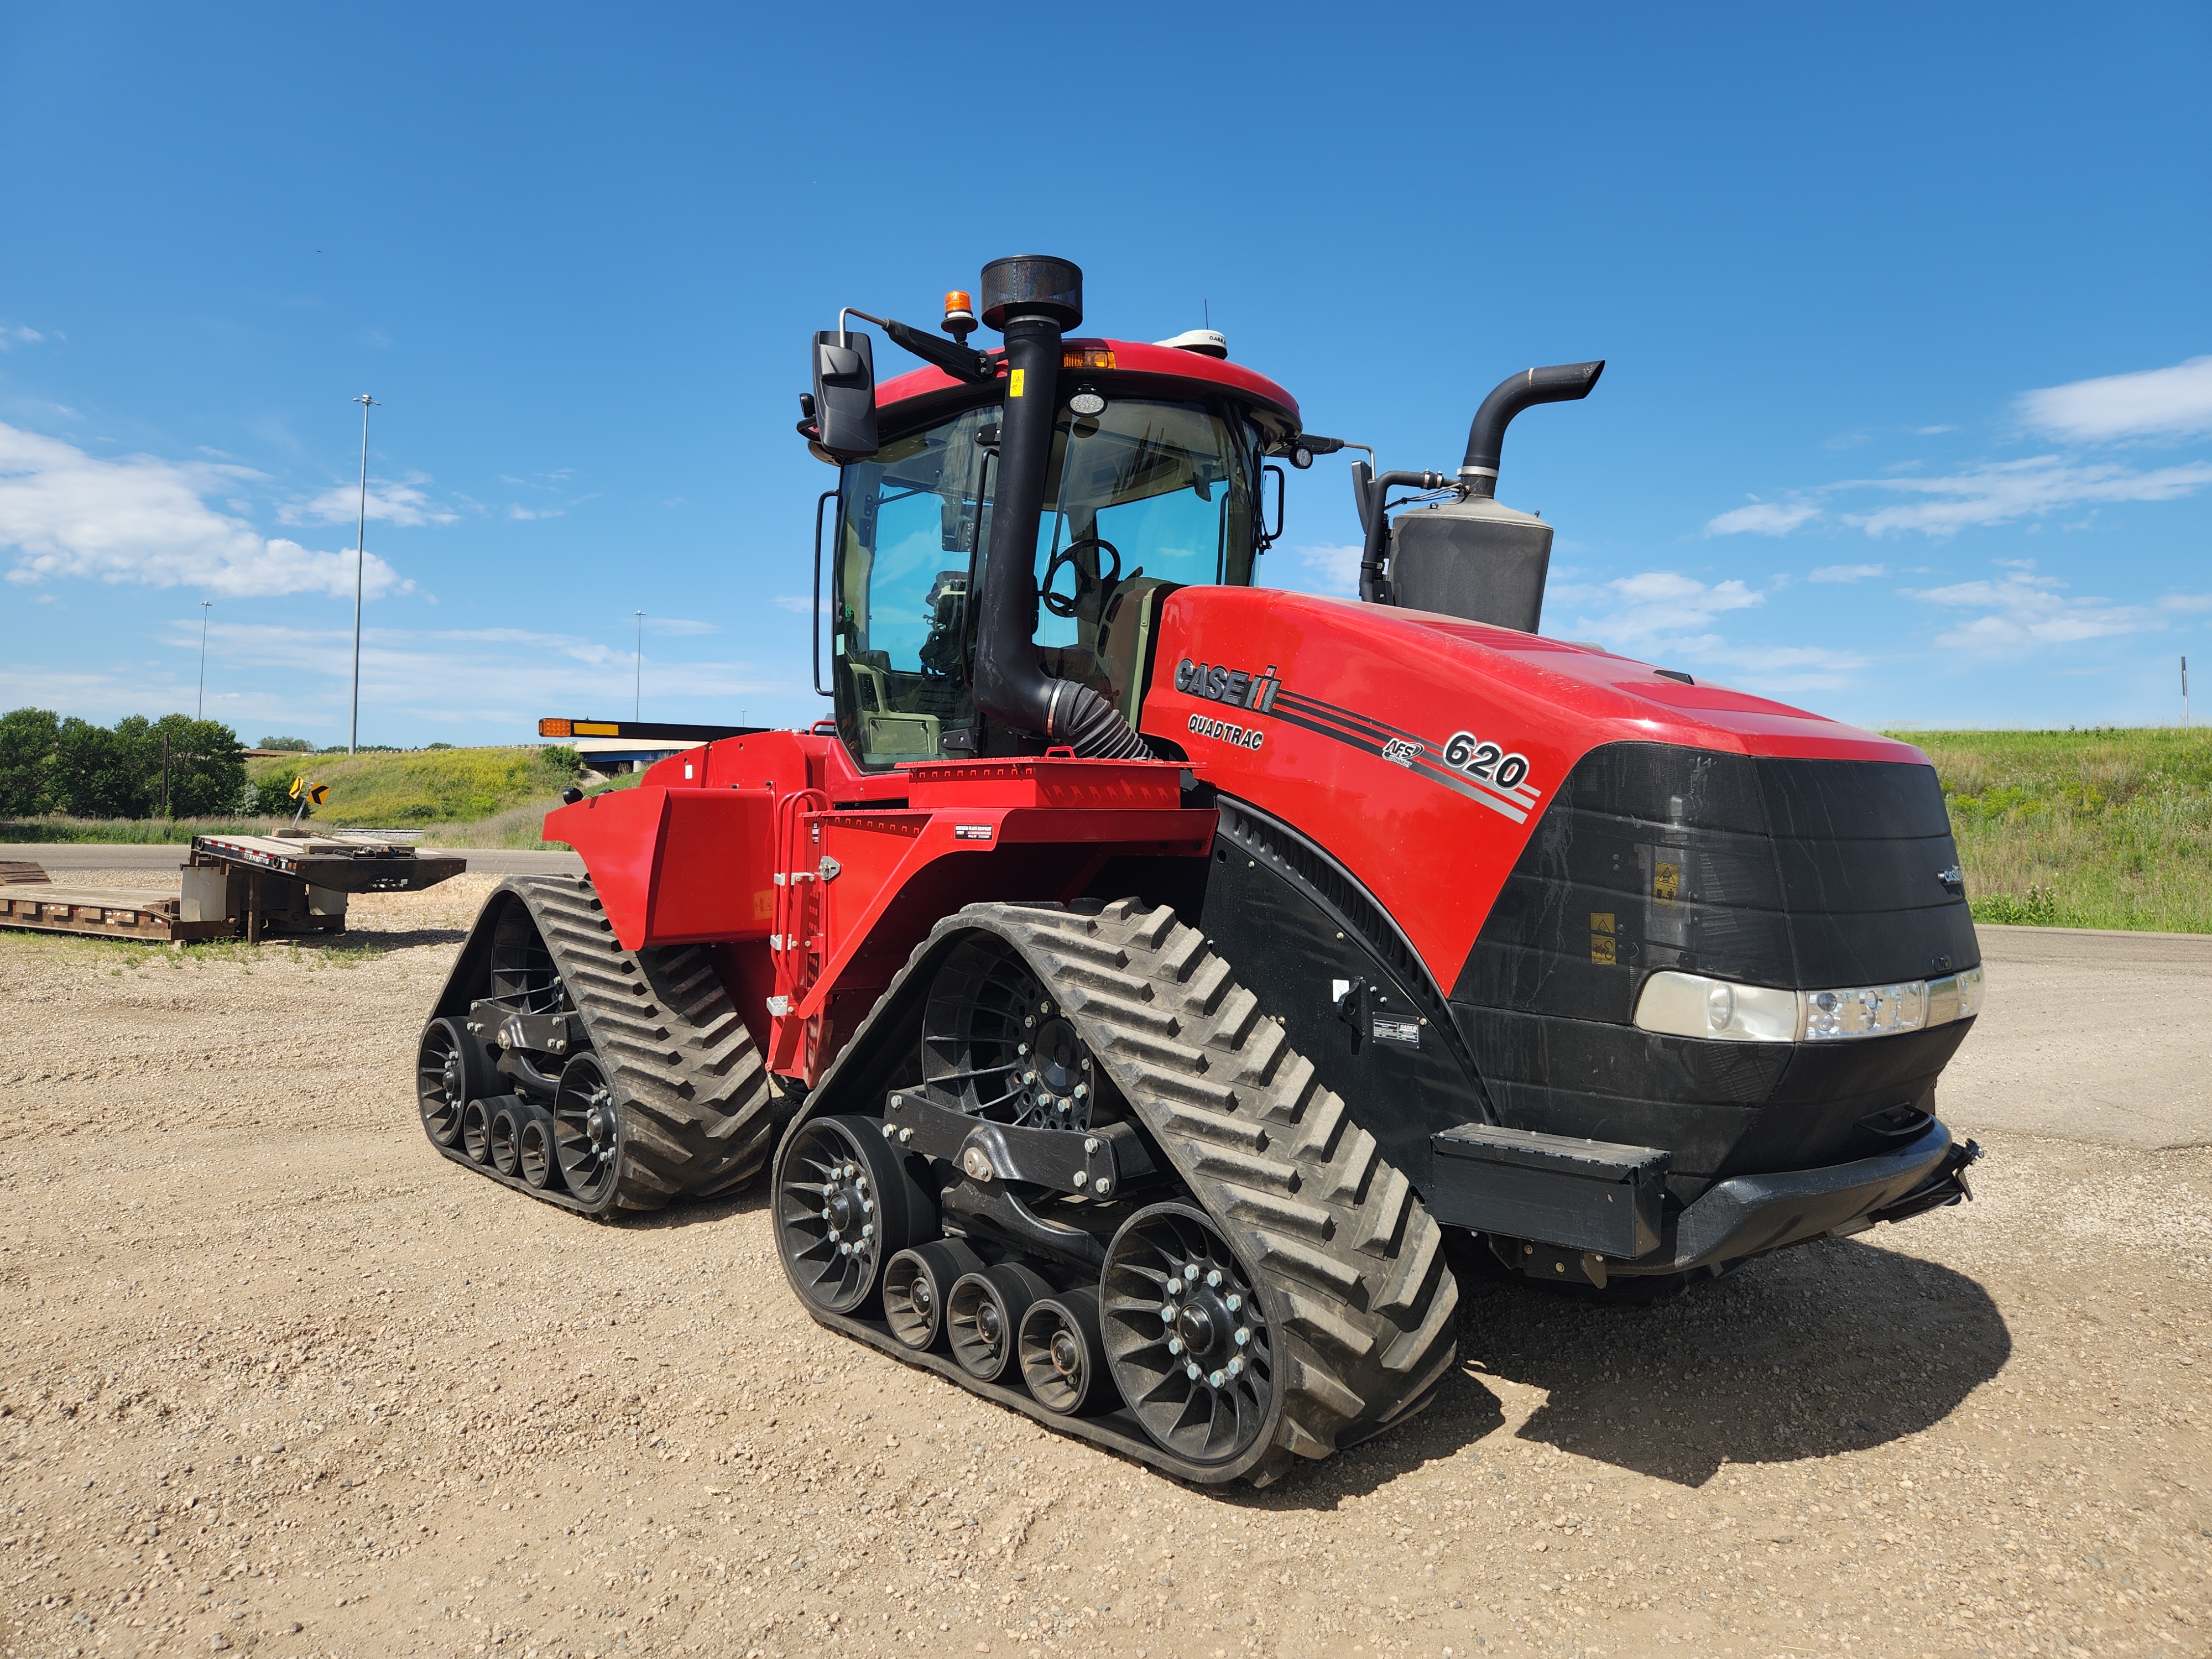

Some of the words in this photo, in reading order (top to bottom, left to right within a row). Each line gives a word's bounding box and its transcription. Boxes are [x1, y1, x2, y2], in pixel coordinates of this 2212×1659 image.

[1175, 658, 1250, 705] CASE
[1188, 714, 1263, 750] QUADTRAC
[1384, 739, 1416, 758] AFS
[1389, 755, 1411, 768] CONNECT
[1443, 731, 1529, 790] 620
